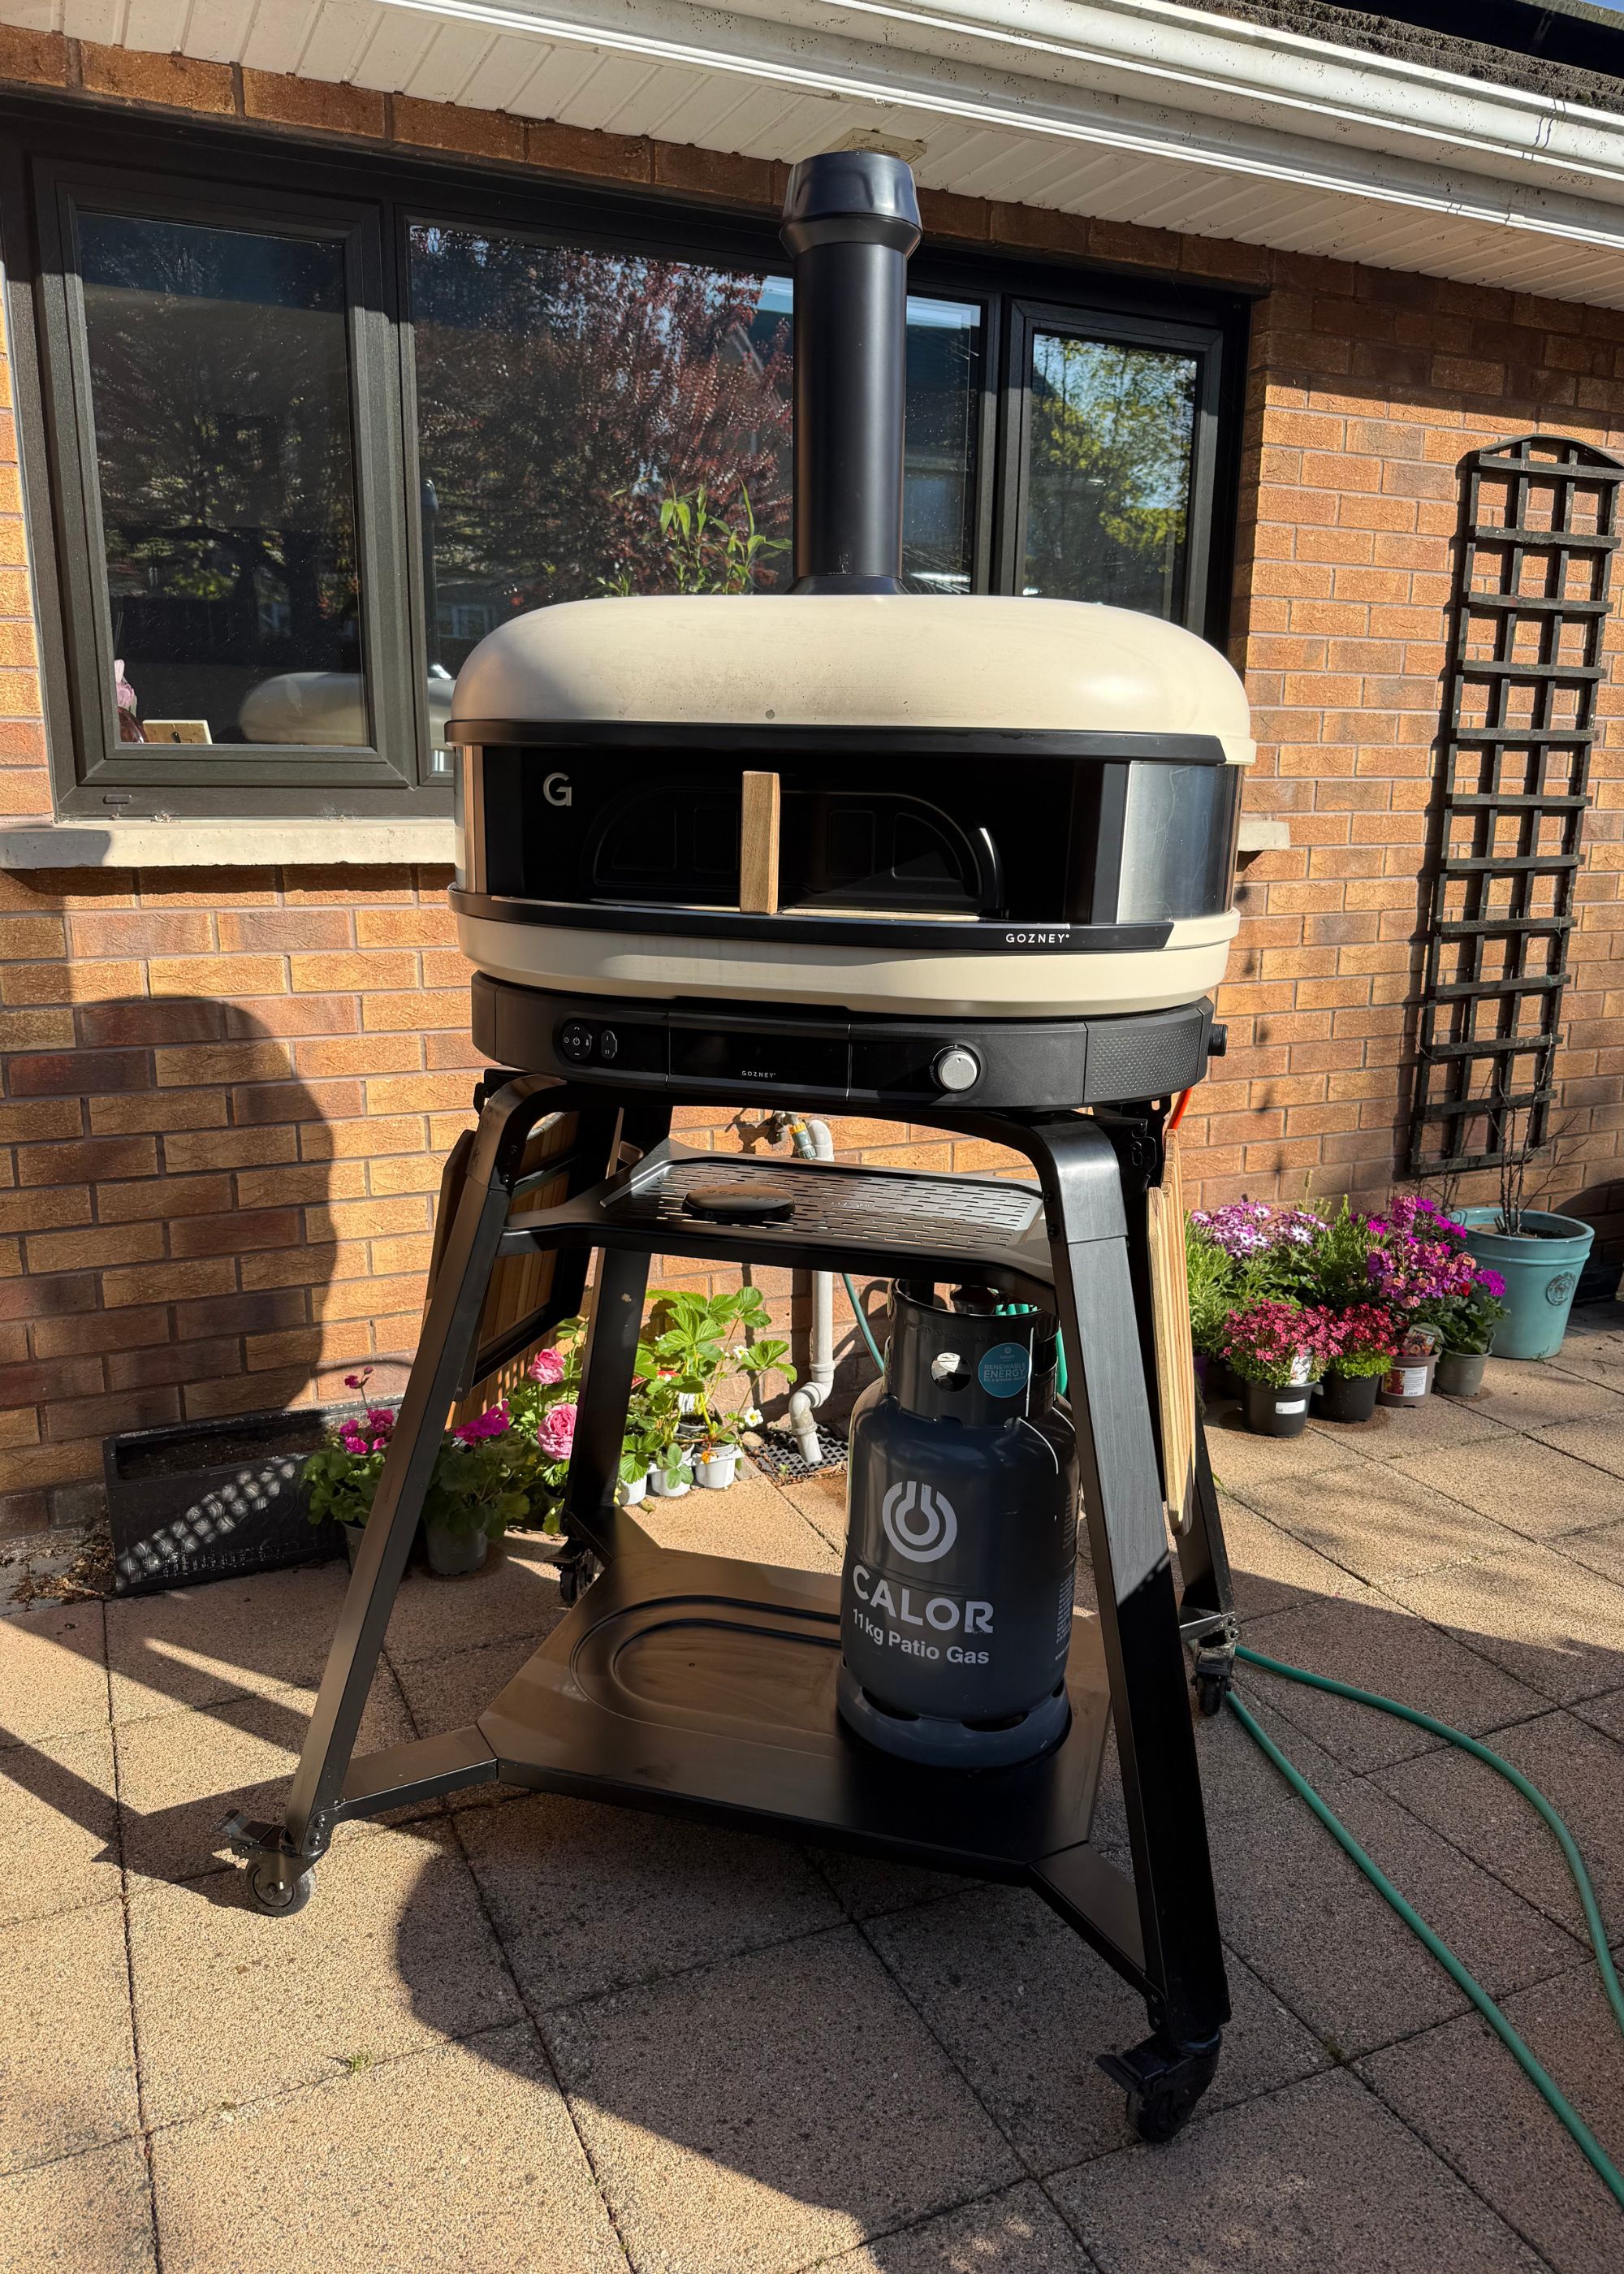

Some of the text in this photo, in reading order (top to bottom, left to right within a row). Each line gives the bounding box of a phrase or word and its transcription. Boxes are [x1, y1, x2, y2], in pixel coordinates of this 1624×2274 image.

[542, 772, 572, 806] G
[984, 1362, 1026, 1370] RENEWABLE
[984, 1368, 1026, 1378] ENERGY
[853, 1564, 994, 1633] CALOR
[853, 1608, 990, 1664] 11kg Patio Gas
